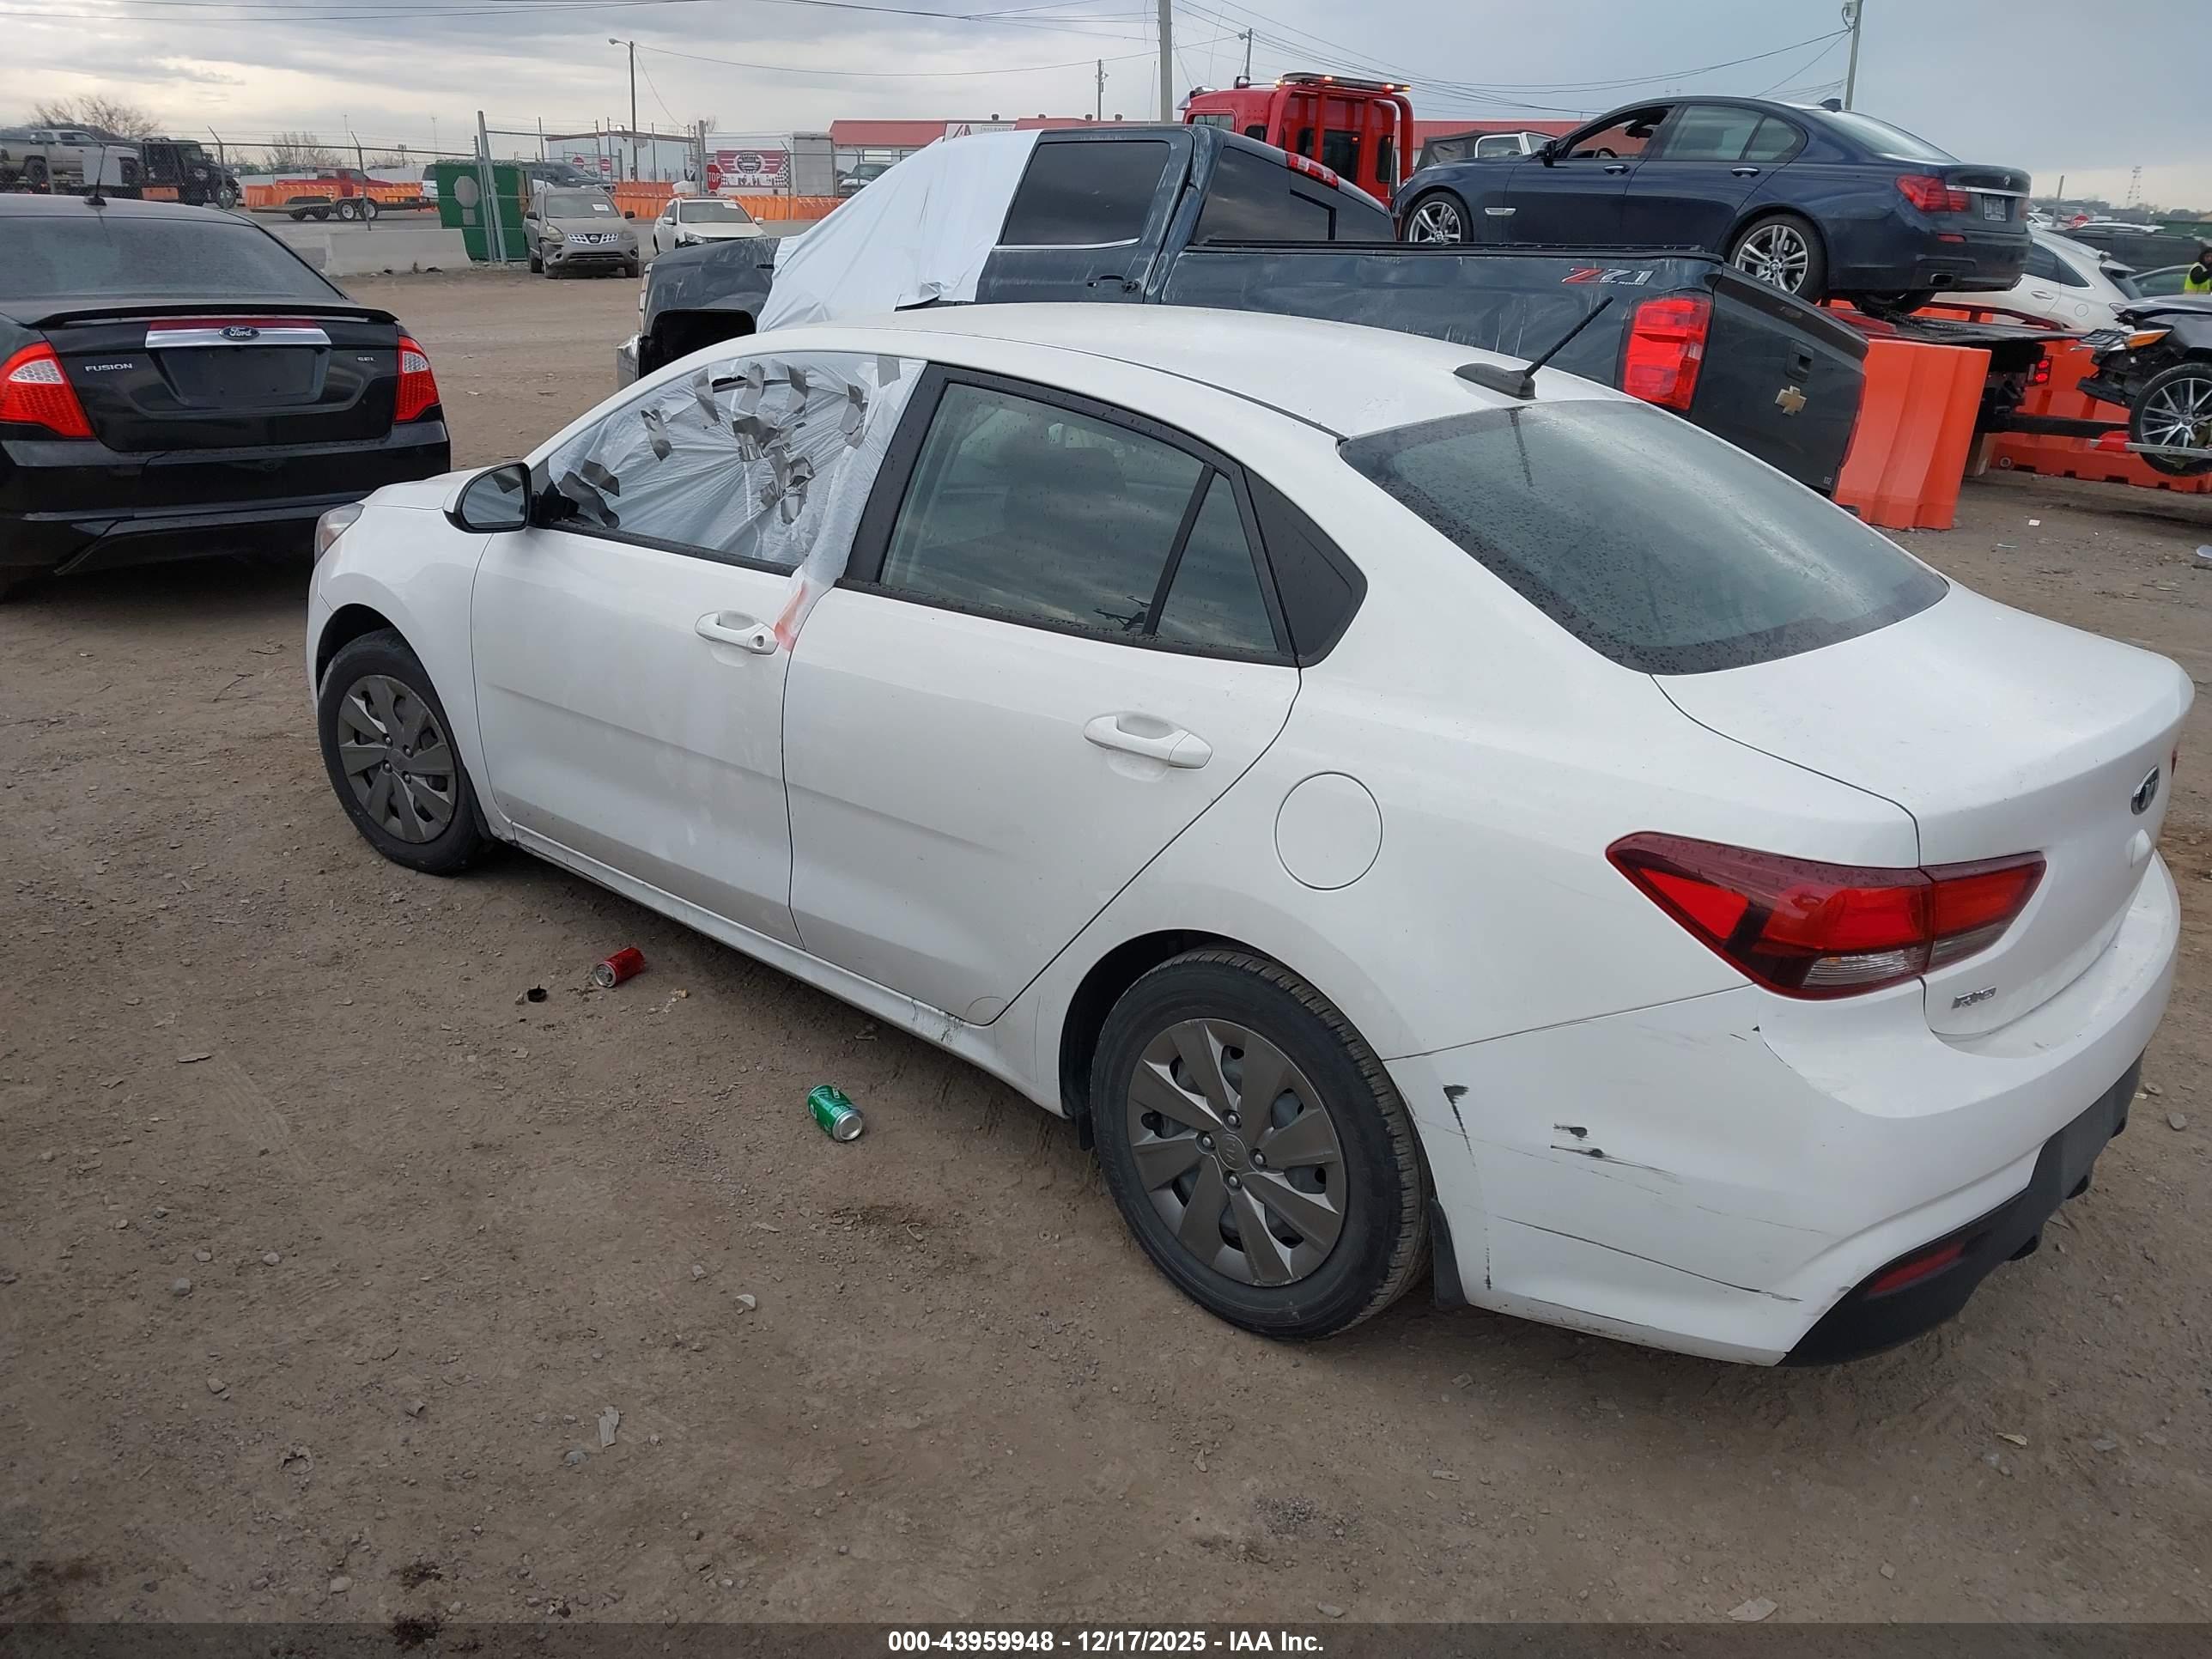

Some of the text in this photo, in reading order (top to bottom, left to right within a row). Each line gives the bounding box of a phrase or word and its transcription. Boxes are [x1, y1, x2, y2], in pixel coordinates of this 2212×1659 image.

[708, 172, 720, 183] TOP
[1561, 267, 1656, 285] Z71
[229, 327, 252, 337] Ford
[85, 362, 133, 373] FUSION
